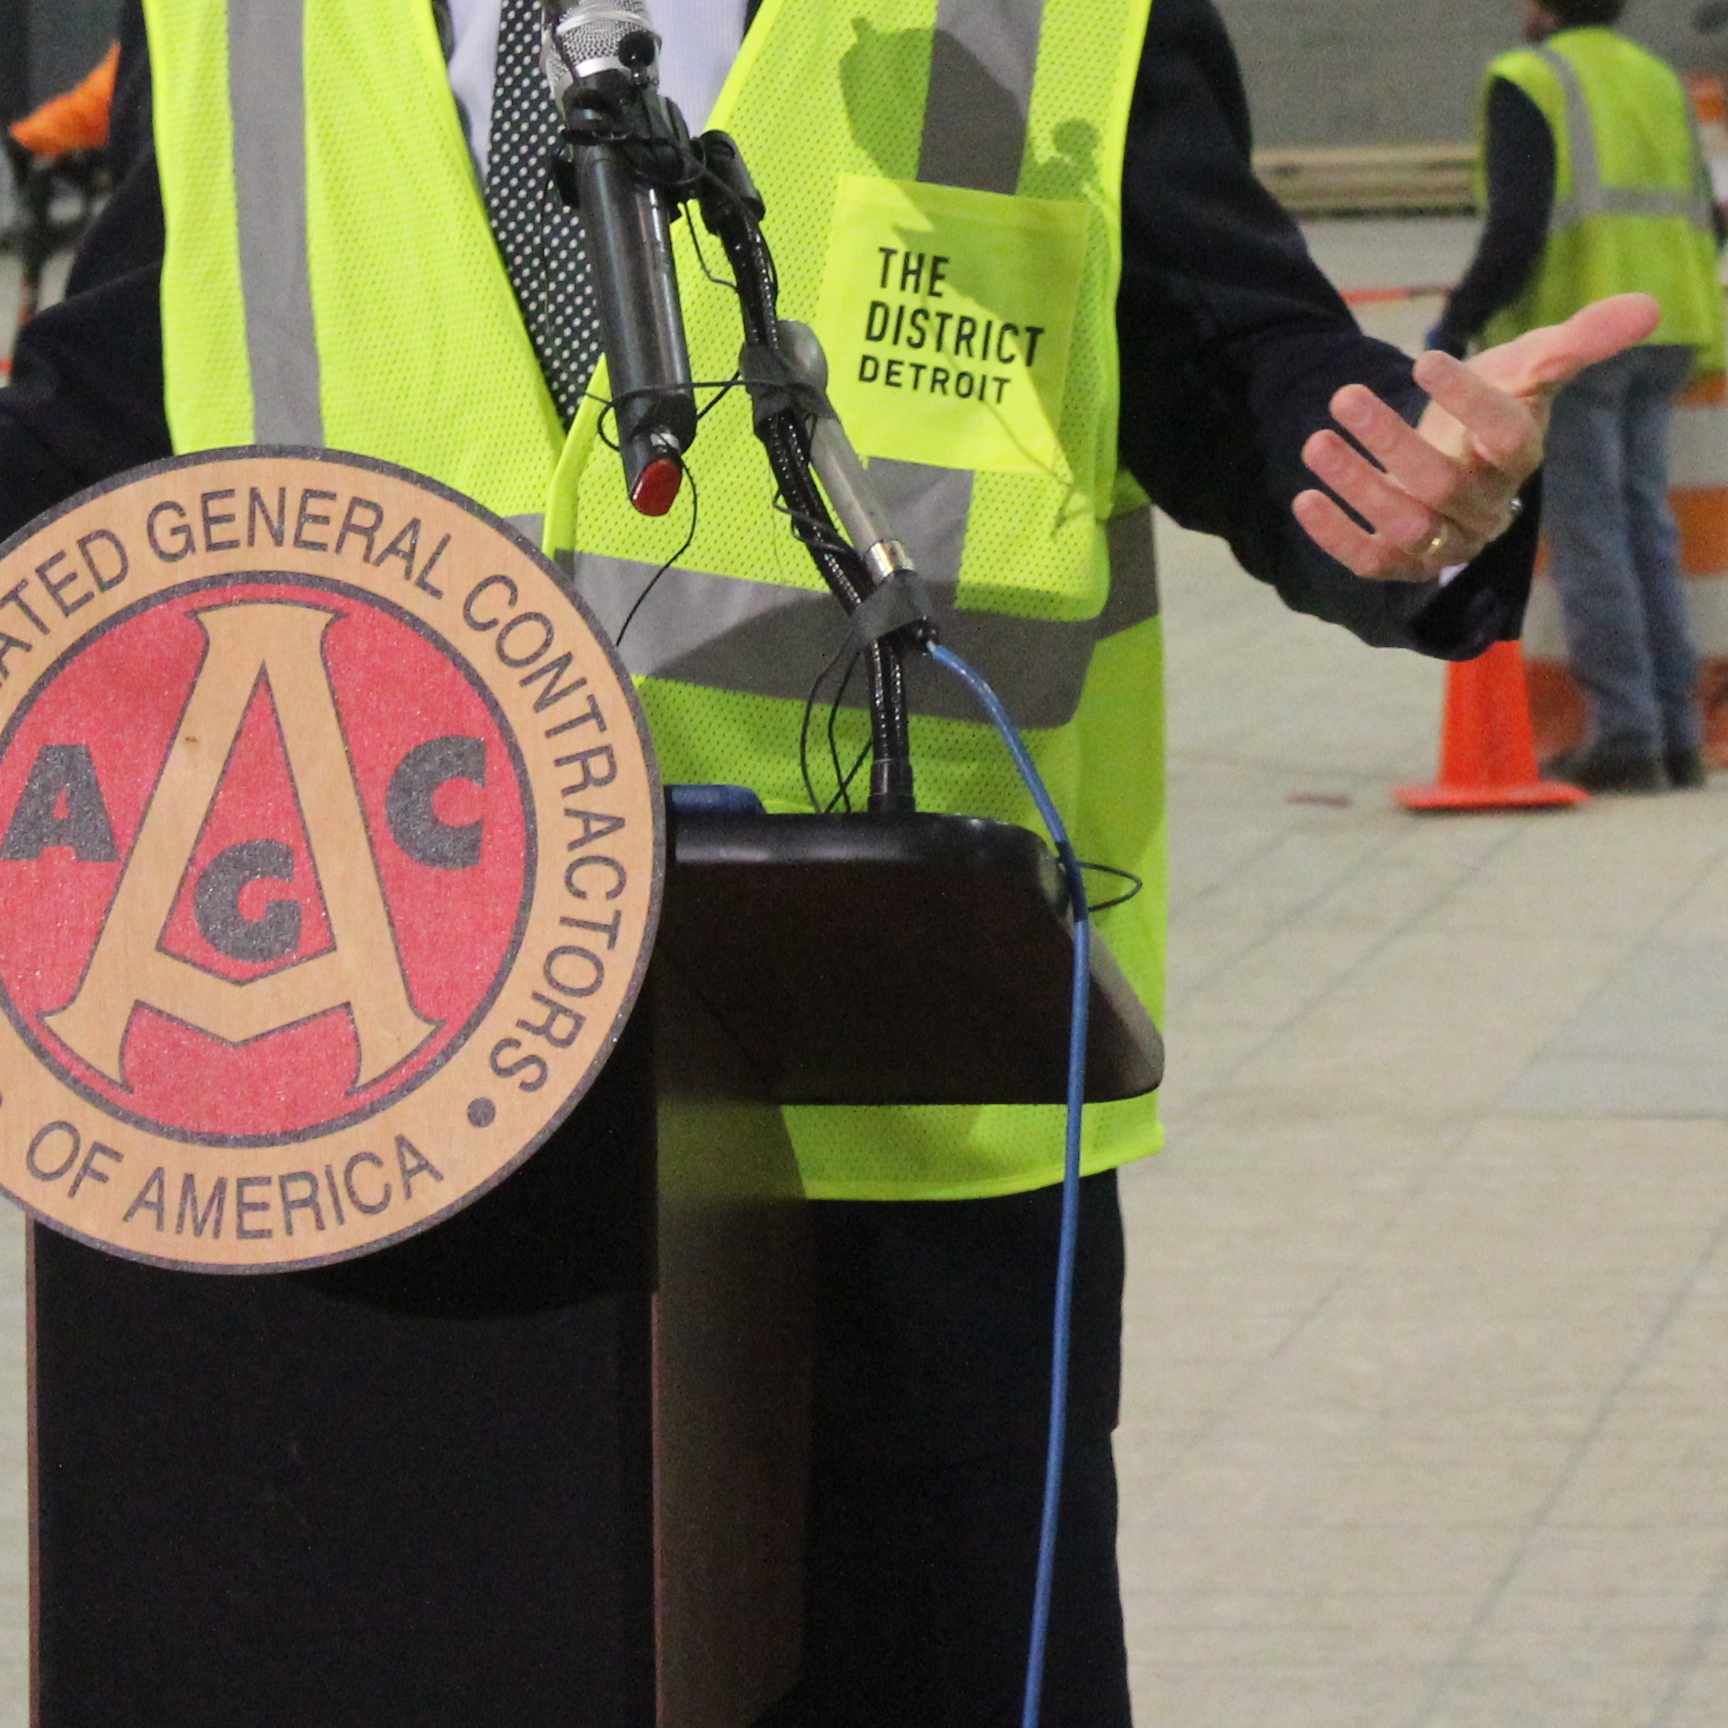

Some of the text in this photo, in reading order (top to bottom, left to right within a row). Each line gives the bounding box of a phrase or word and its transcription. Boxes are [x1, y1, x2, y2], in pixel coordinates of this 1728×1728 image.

[879, 247, 950, 298] THE
[865, 300, 1045, 367] DISTRICT
[857, 354, 1011, 404] DETROIT
[145, 486, 457, 600] GENERAL
[462, 573, 628, 1094] CONTRACTORS
[26, 1119, 445, 1241] OF AMERICA
